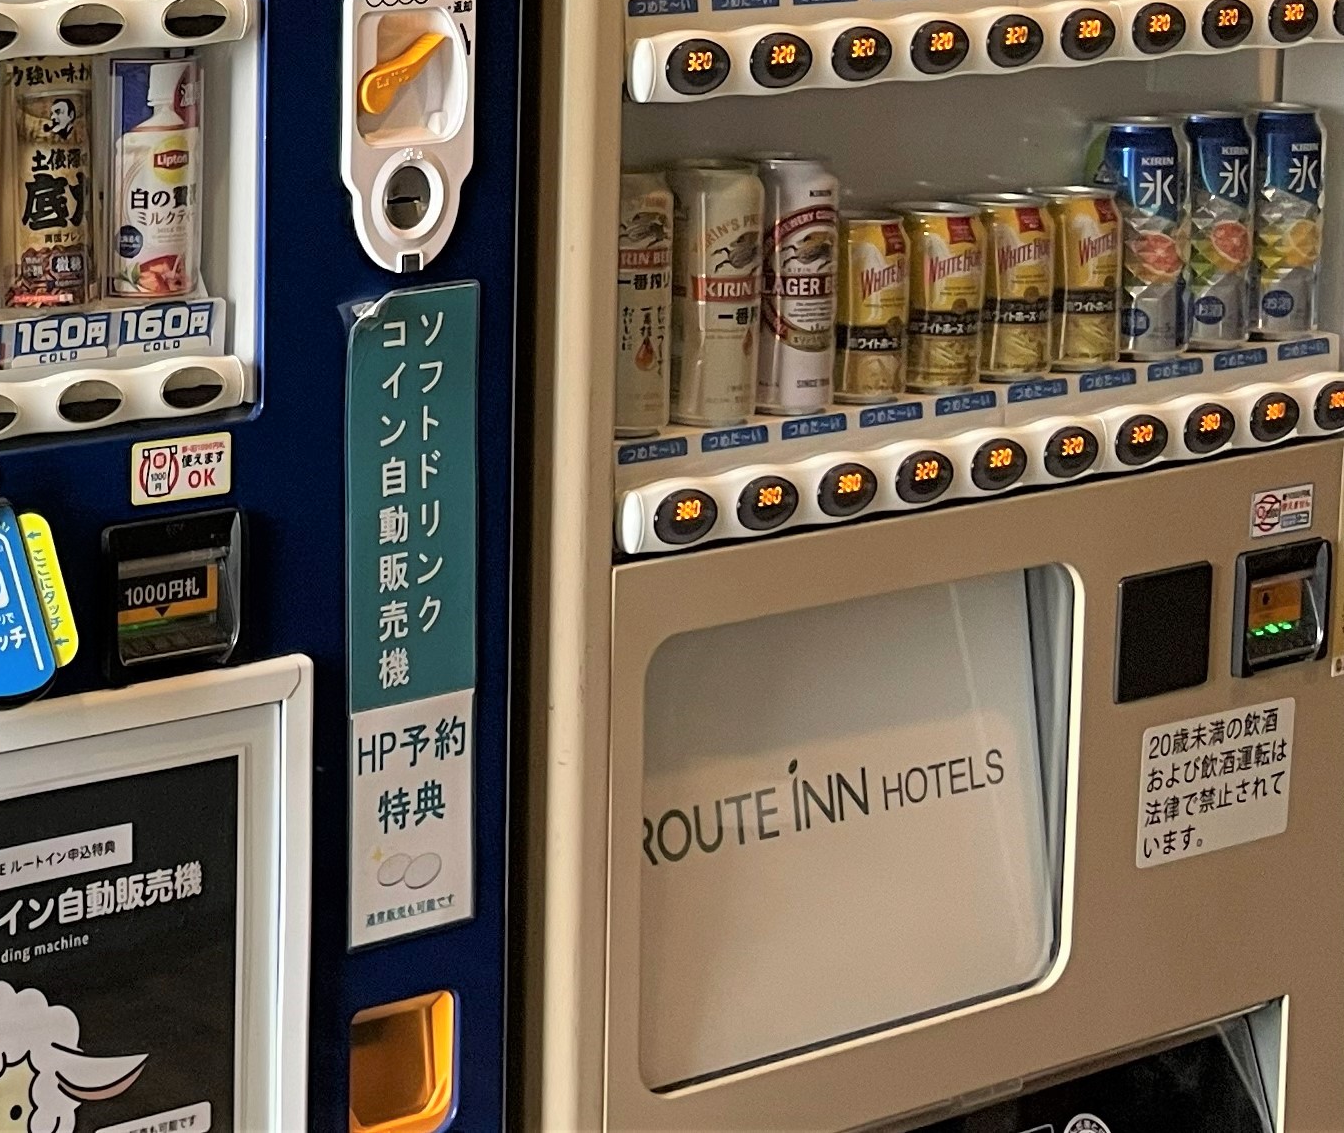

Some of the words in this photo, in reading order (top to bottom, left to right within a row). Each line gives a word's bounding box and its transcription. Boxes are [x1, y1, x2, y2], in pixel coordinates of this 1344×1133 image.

[687, 51, 713, 72] 320
[1139, 169, 1175, 207] 氷
[188, 467, 216, 489] OK
[415, 310, 445, 634] ソフトドリンク
[377, 319, 410, 688] コイン自動販売機
[124, 577, 200, 607] 1000円札
[356, 718, 468, 779] HP予約
[1149, 708, 1279, 761] 20歳未満の飲酒
[882, 748, 1005, 813] HOTELS
[1146, 739, 1289, 795] および飲酒運転は
[377, 780, 447, 835] 特典
[1143, 770, 1285, 828] 法律で禁止されて
[1142, 824, 1205, 860] います。
[33, 932, 90, 956] machine
